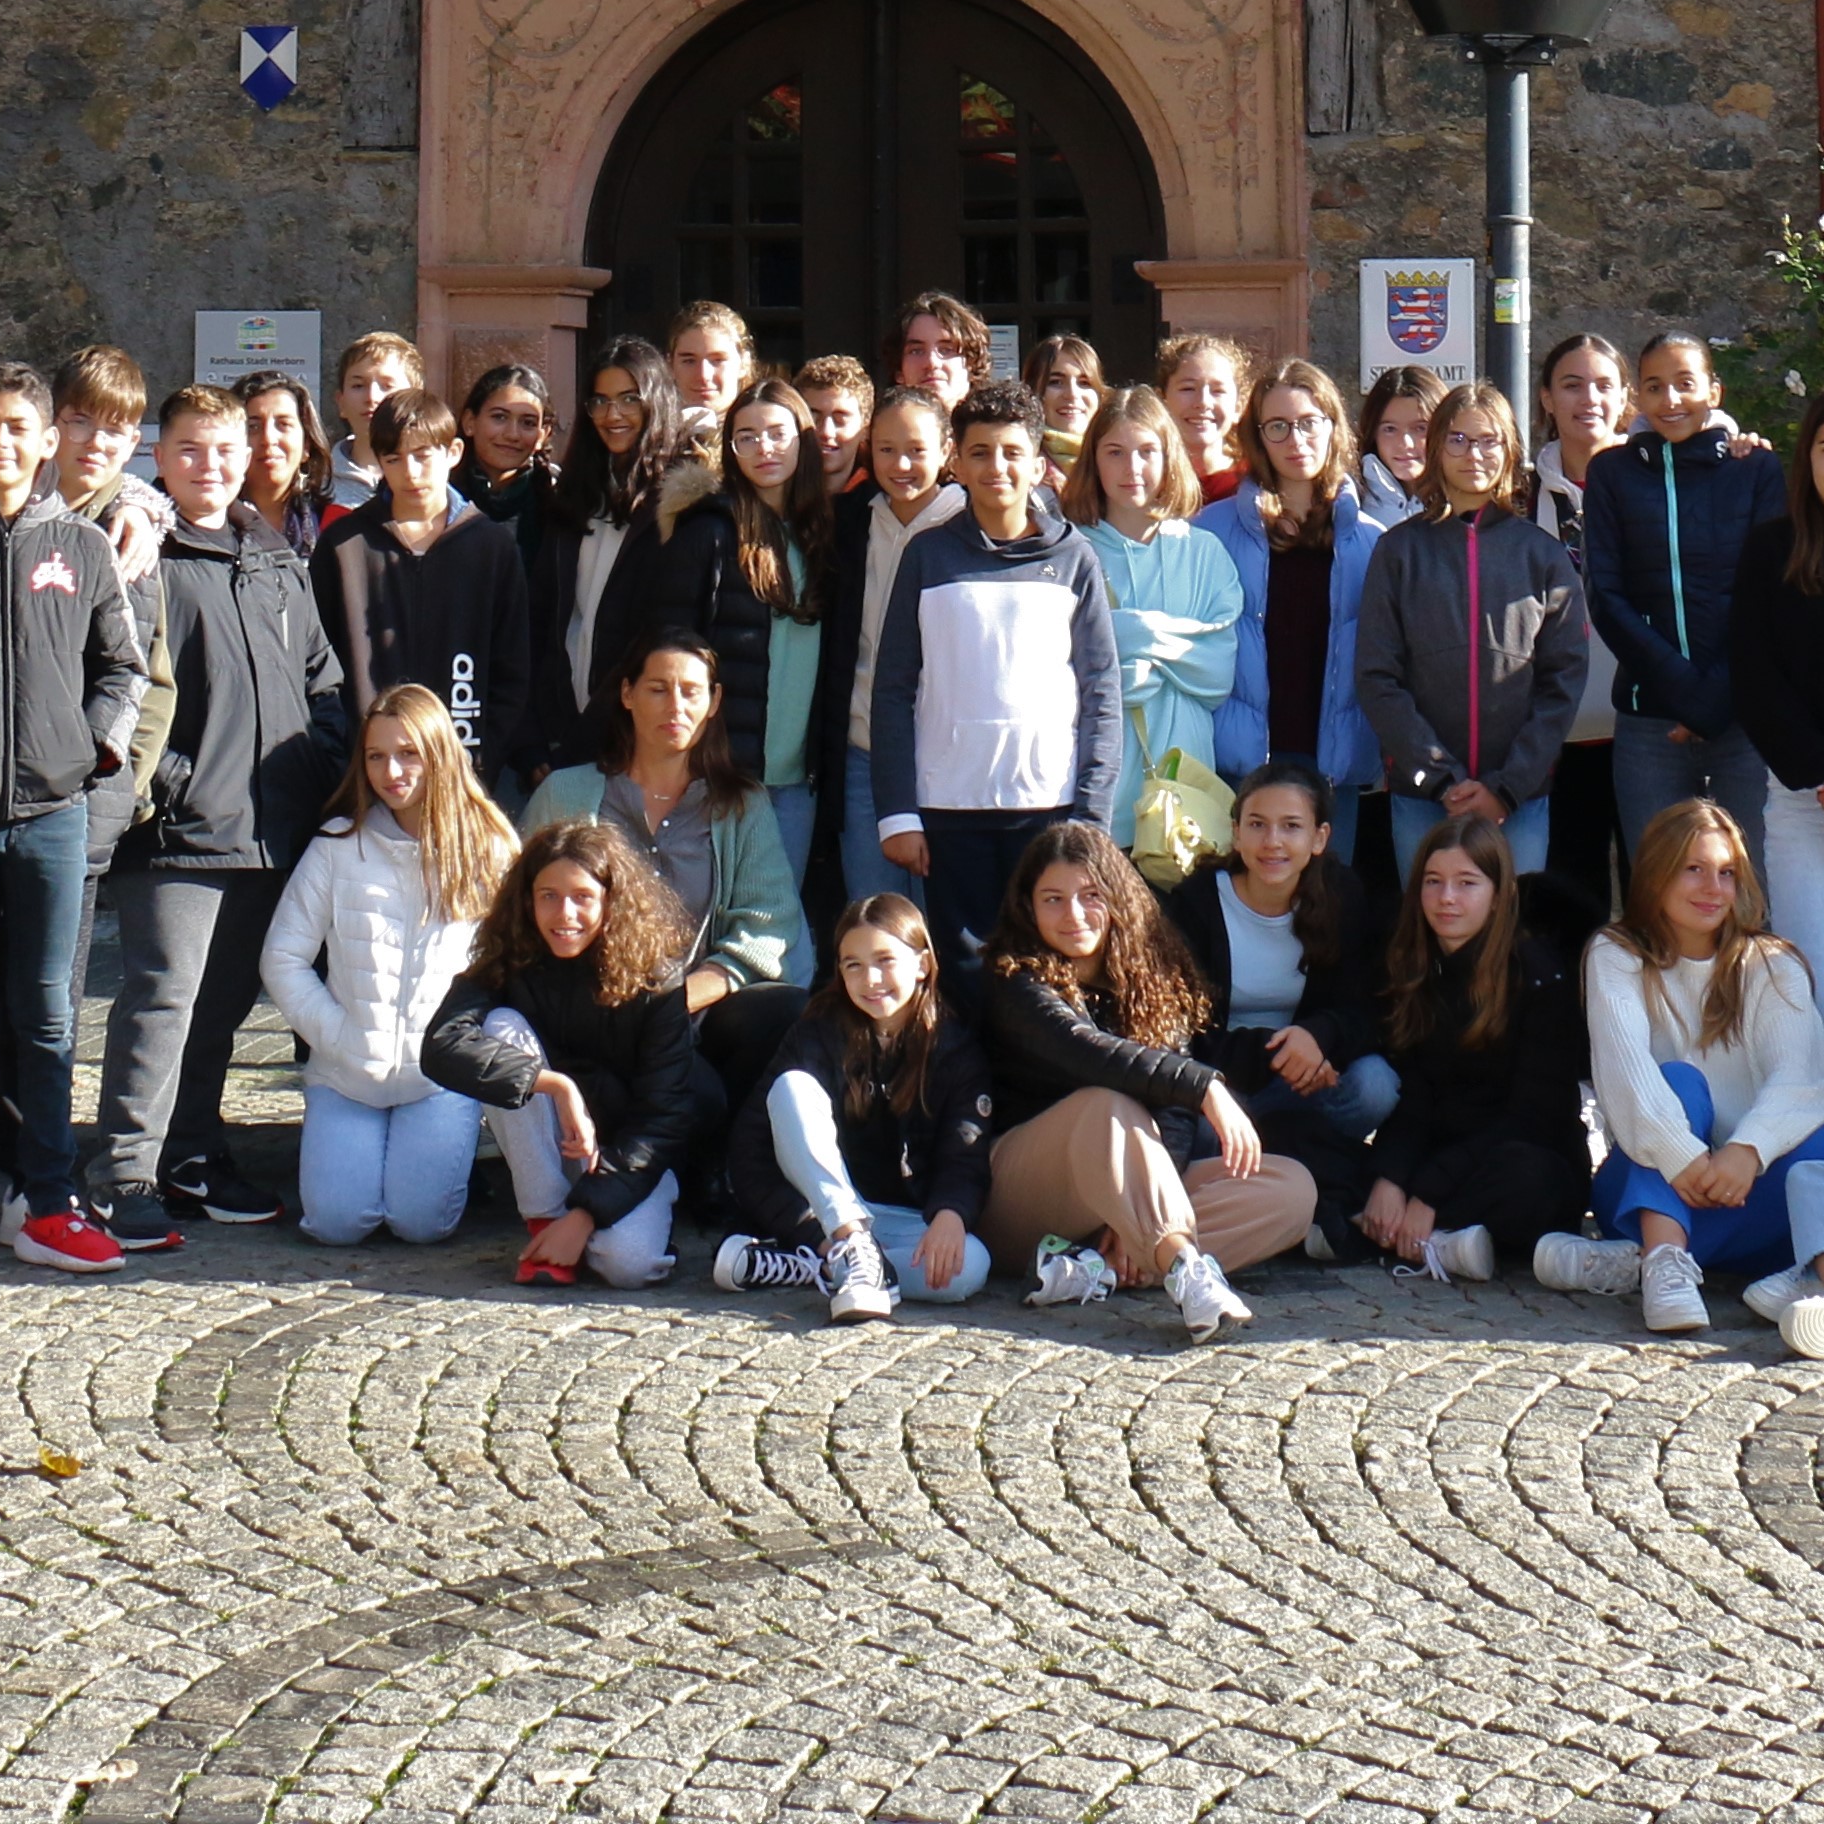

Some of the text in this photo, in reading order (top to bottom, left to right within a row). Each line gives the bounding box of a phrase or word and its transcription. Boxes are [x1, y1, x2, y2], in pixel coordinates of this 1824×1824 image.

[209, 357, 306, 366] Rathaus Stadt Herborn
[450, 652, 482, 766] adid
